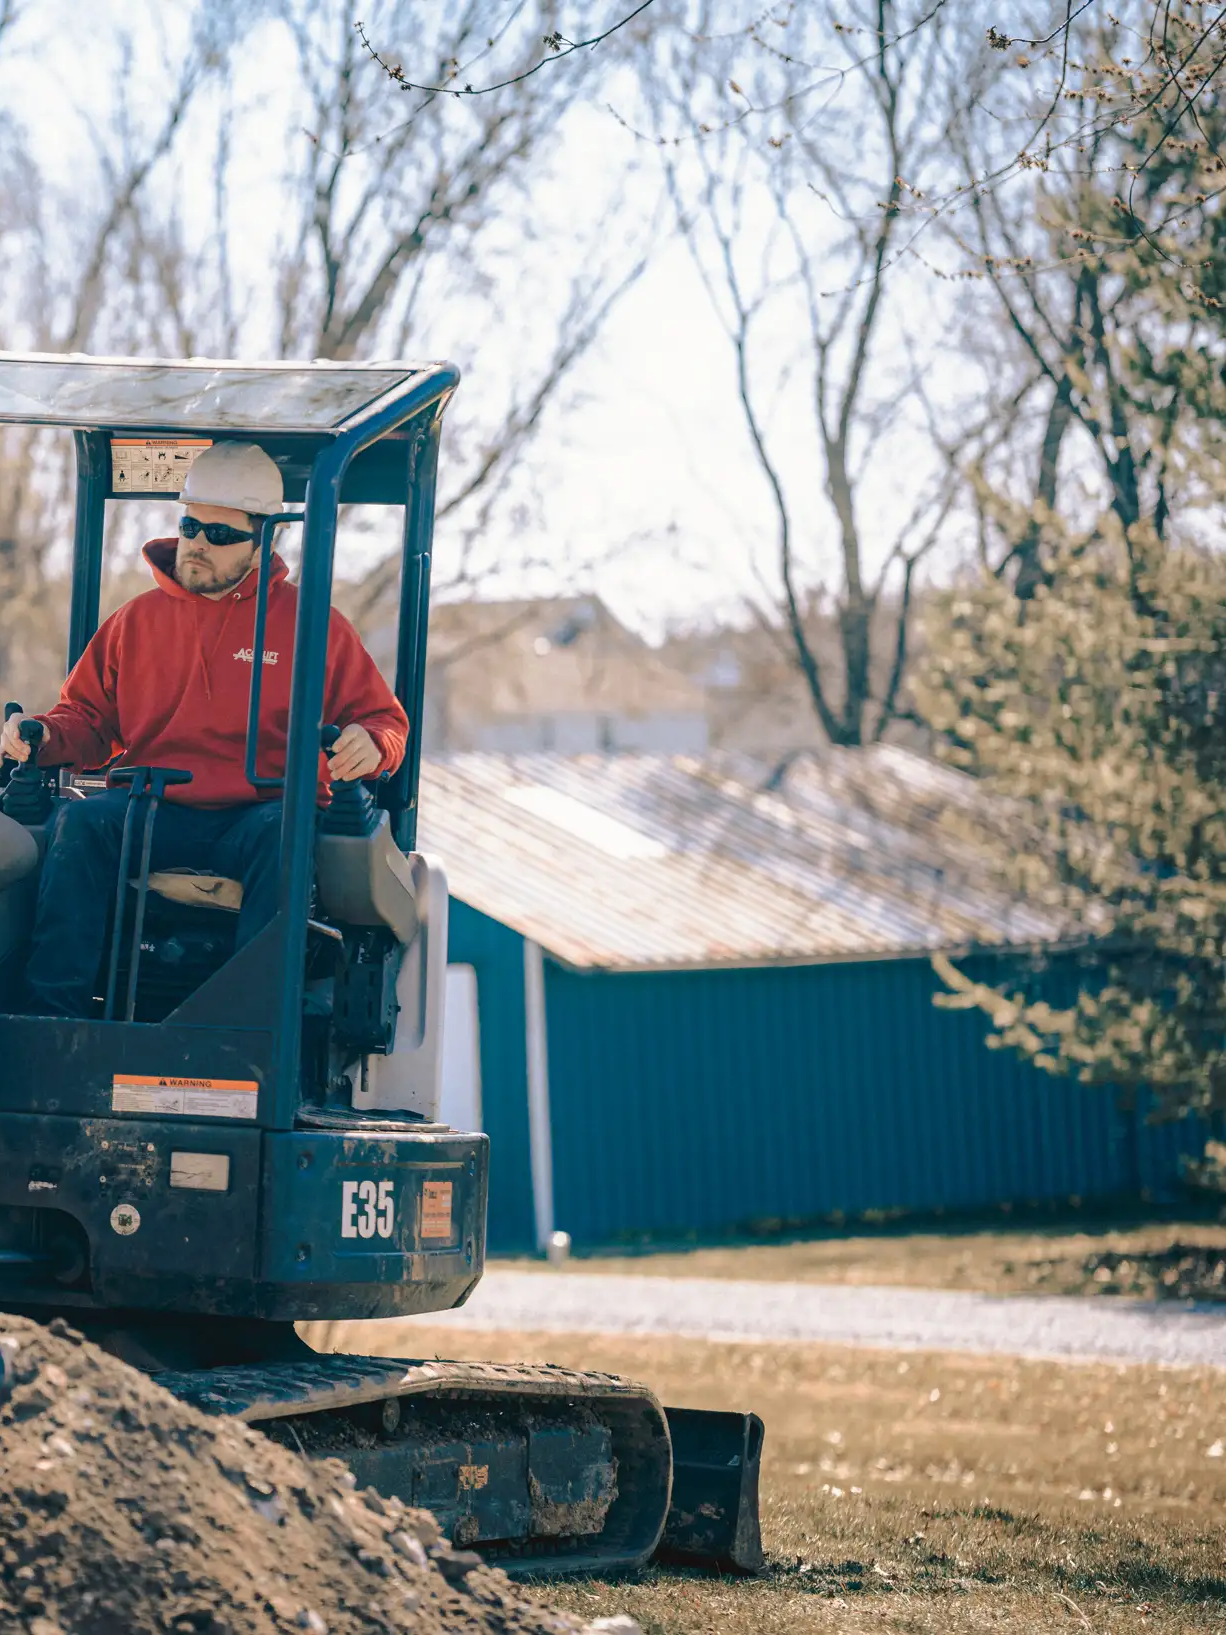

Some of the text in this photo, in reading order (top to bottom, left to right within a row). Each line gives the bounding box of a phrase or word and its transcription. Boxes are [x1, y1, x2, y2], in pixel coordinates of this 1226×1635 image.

[233, 647, 279, 662] ACLIFT
[169, 1078, 212, 1088] WARNING
[341, 1180, 395, 1239] E35
